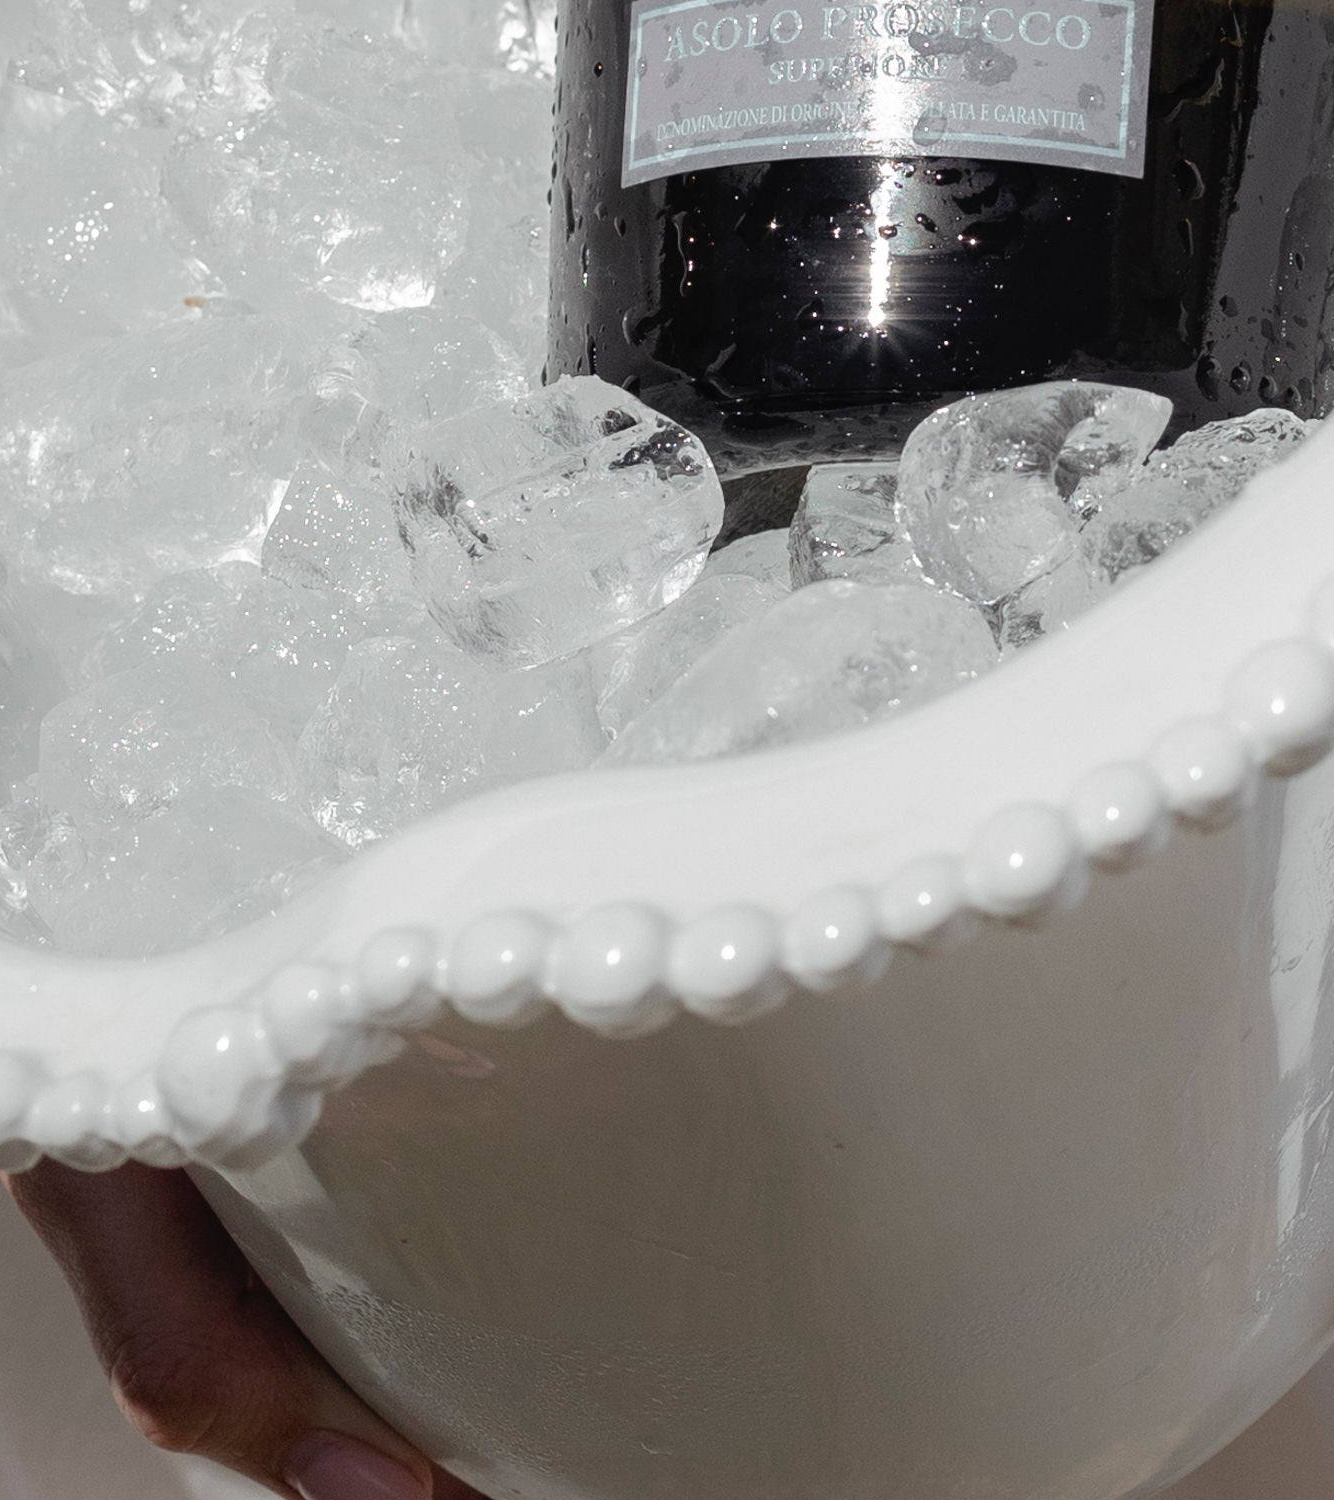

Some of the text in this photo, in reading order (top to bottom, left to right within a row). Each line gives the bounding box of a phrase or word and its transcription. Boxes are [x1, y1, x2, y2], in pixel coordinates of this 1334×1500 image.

[665, 3, 1092, 62] ASOLO PROSECCO
[768, 53, 950, 85] SUPERIORE
[656, 106, 768, 142] DENOMINAZIONE
[771, 105, 787, 122] DI
[981, 104, 990, 121] E
[994, 104, 1086, 132] GARANTITA
